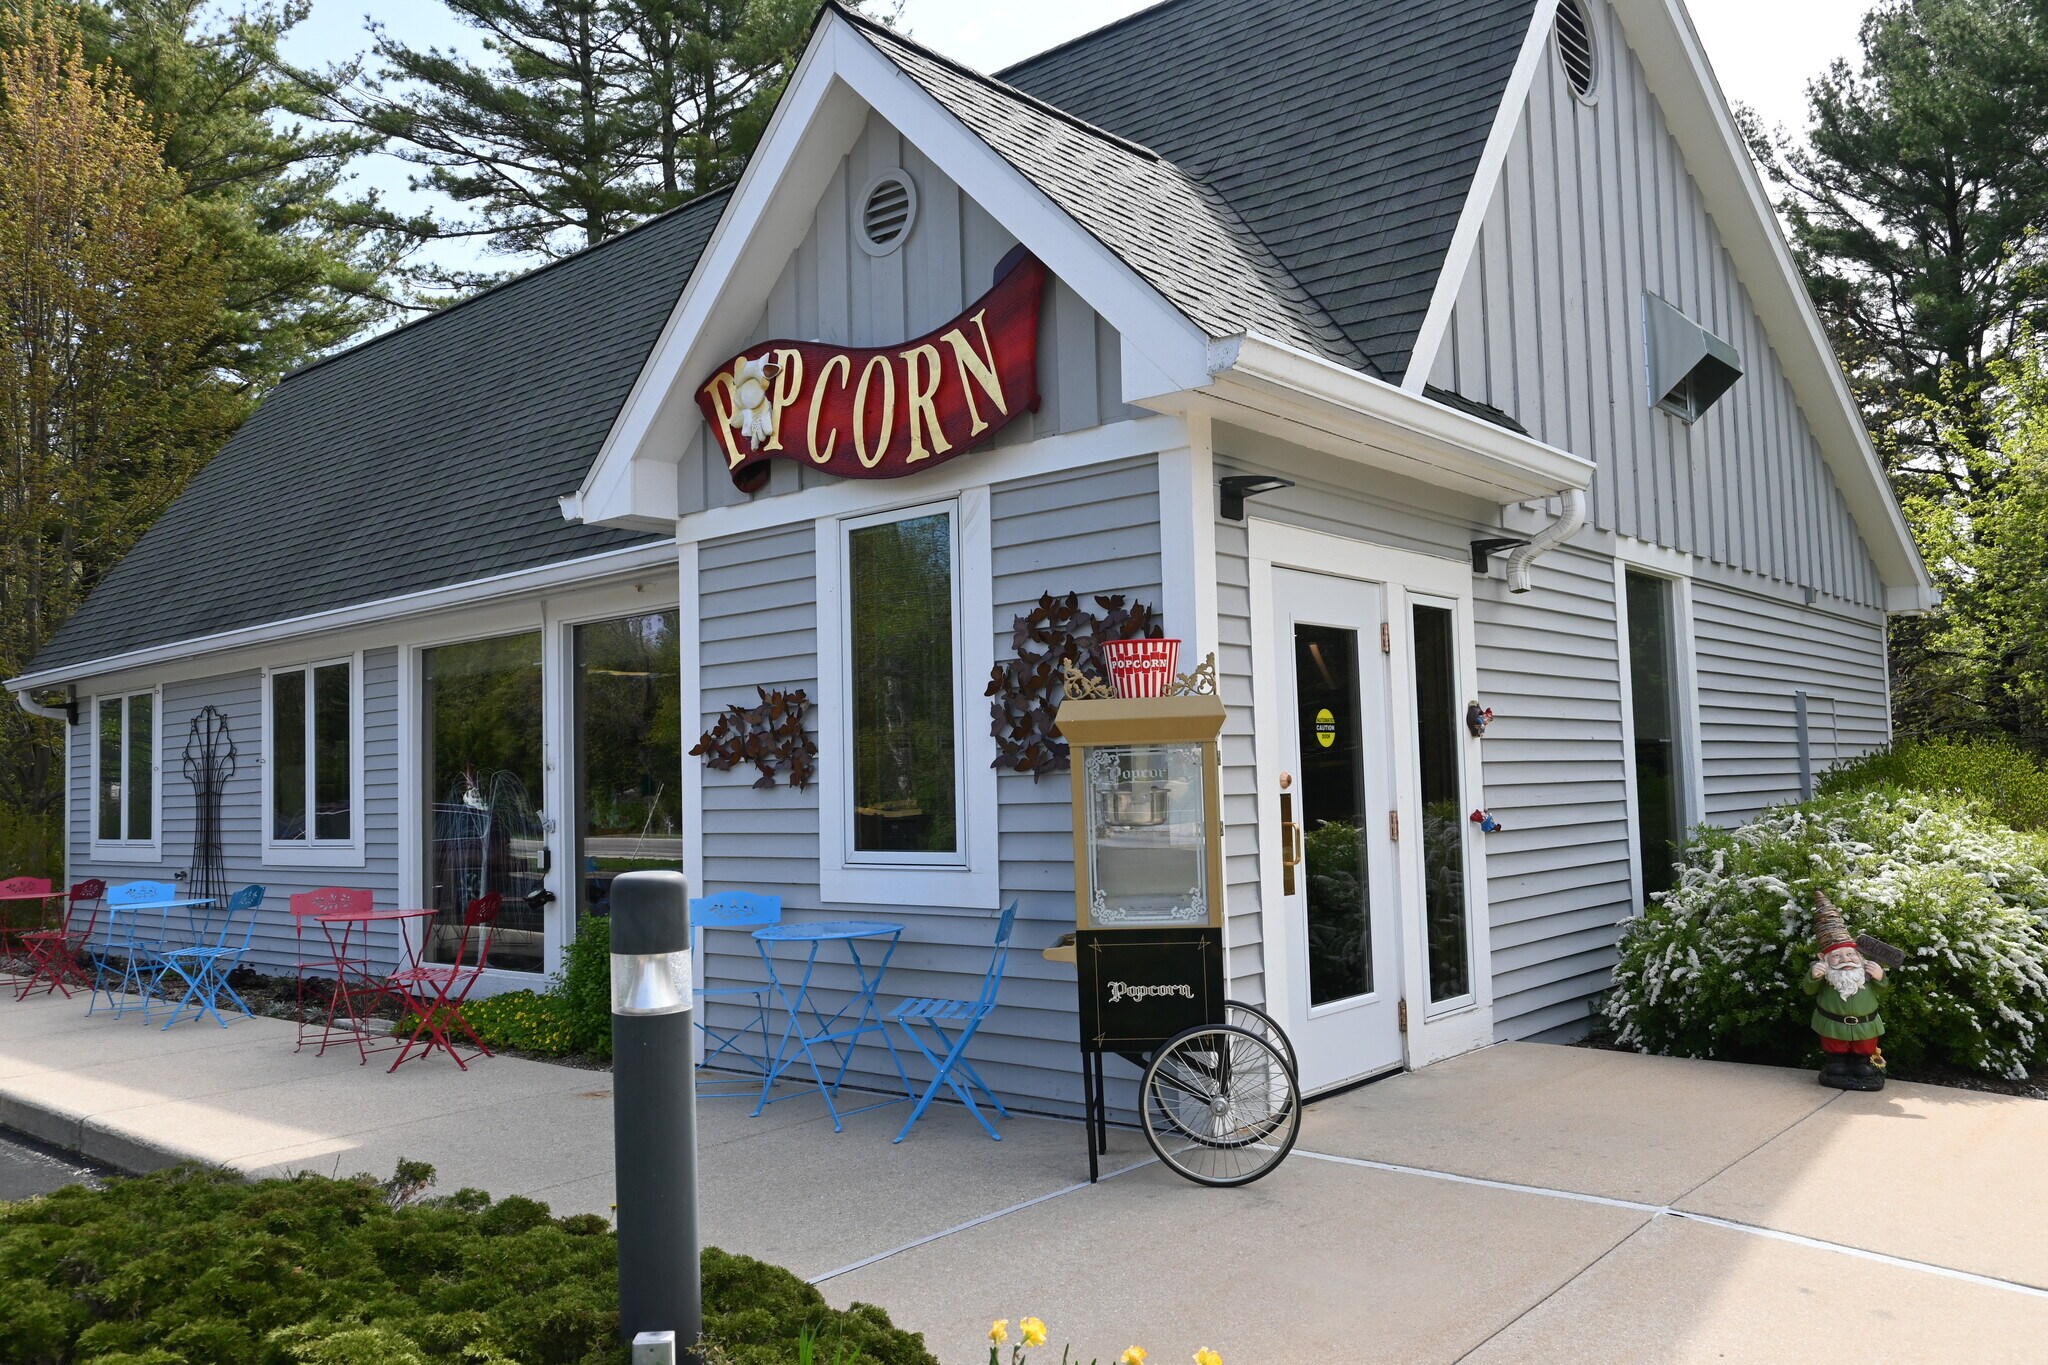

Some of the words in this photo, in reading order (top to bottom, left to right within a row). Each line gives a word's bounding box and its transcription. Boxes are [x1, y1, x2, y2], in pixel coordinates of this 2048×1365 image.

[704, 308, 1008, 470] PPCORN
[1111, 658, 1168, 669] POPCORN
[1104, 766, 1169, 785] Popcor
[1107, 981, 1195, 1003] Popcorn
